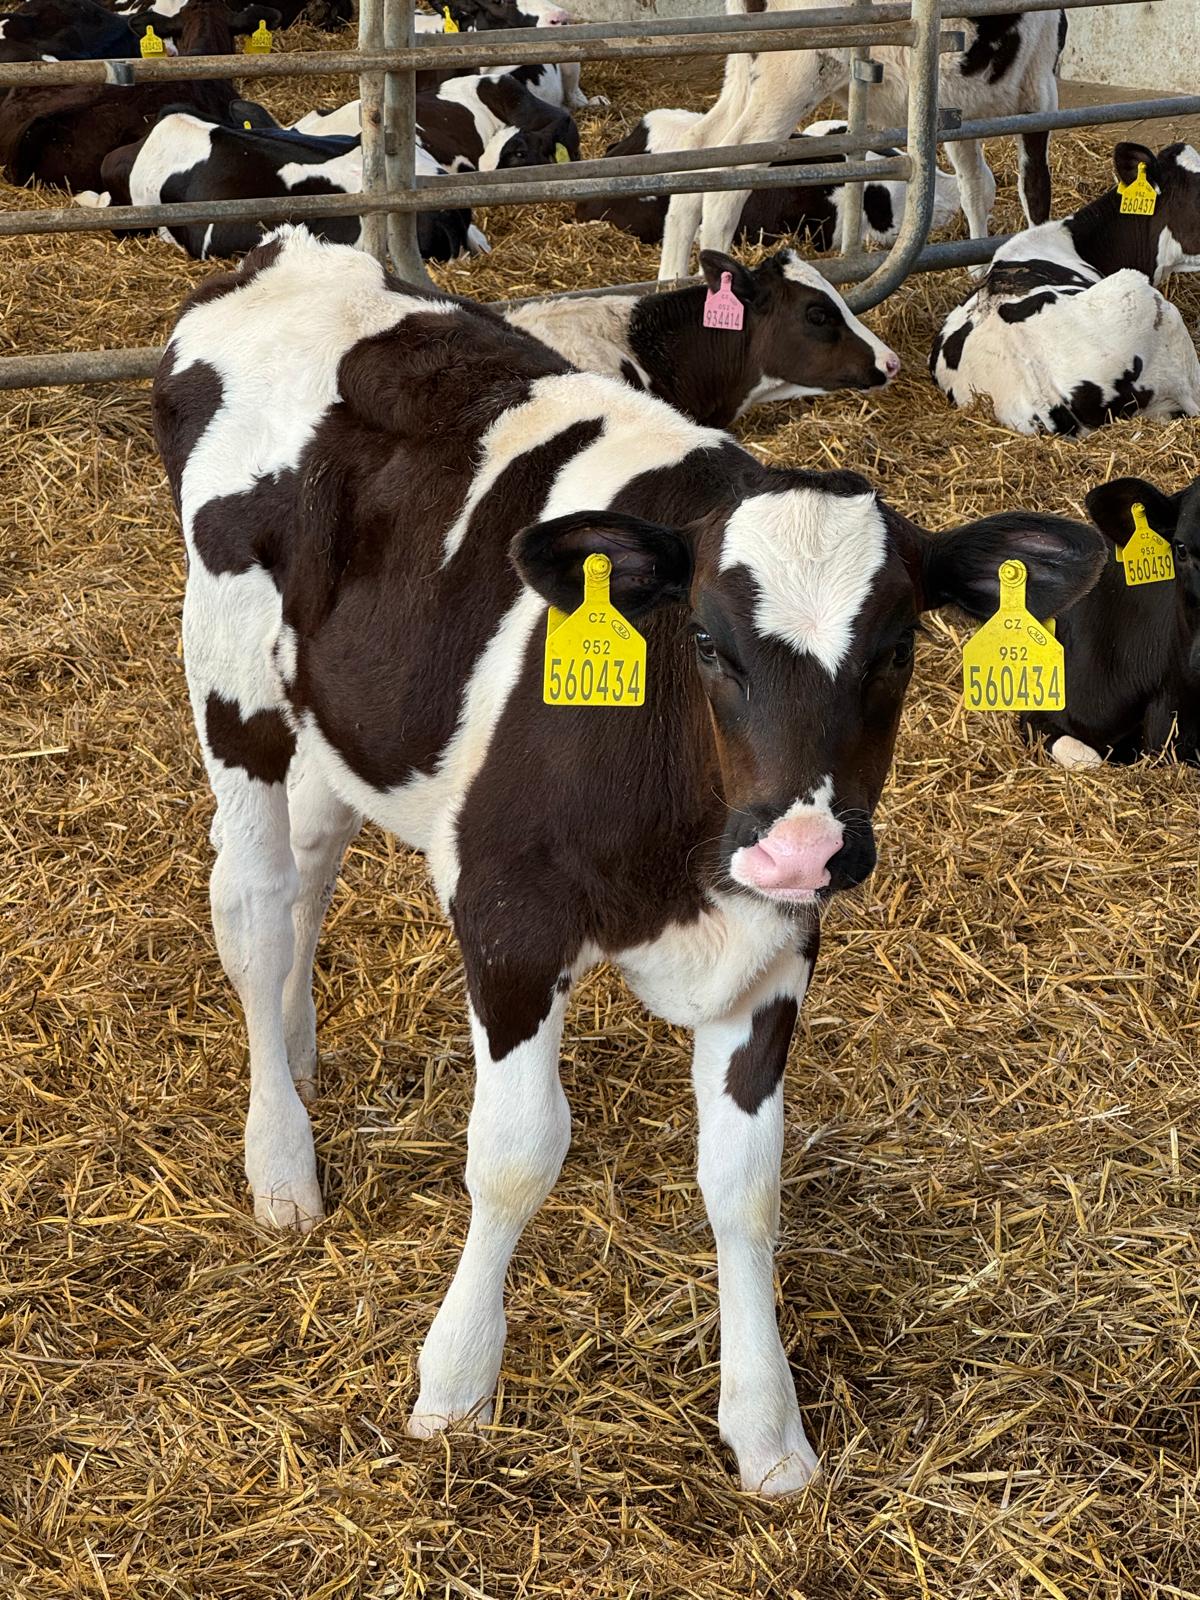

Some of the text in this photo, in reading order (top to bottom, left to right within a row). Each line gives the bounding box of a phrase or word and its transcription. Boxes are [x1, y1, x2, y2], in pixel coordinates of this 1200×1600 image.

[1122, 197, 1155, 213] 560437
[706, 310, 740, 329] 934414
[1141, 547, 1155, 556] 952
[1127, 554, 1172, 582] 560439
[588, 612, 606, 623] CZ
[1003, 618, 1022, 629] CZ
[582, 639, 611, 655] 952
[999, 646, 1028, 661] 952
[549, 658, 640, 702] 560434
[969, 665, 1061, 707] 560434
